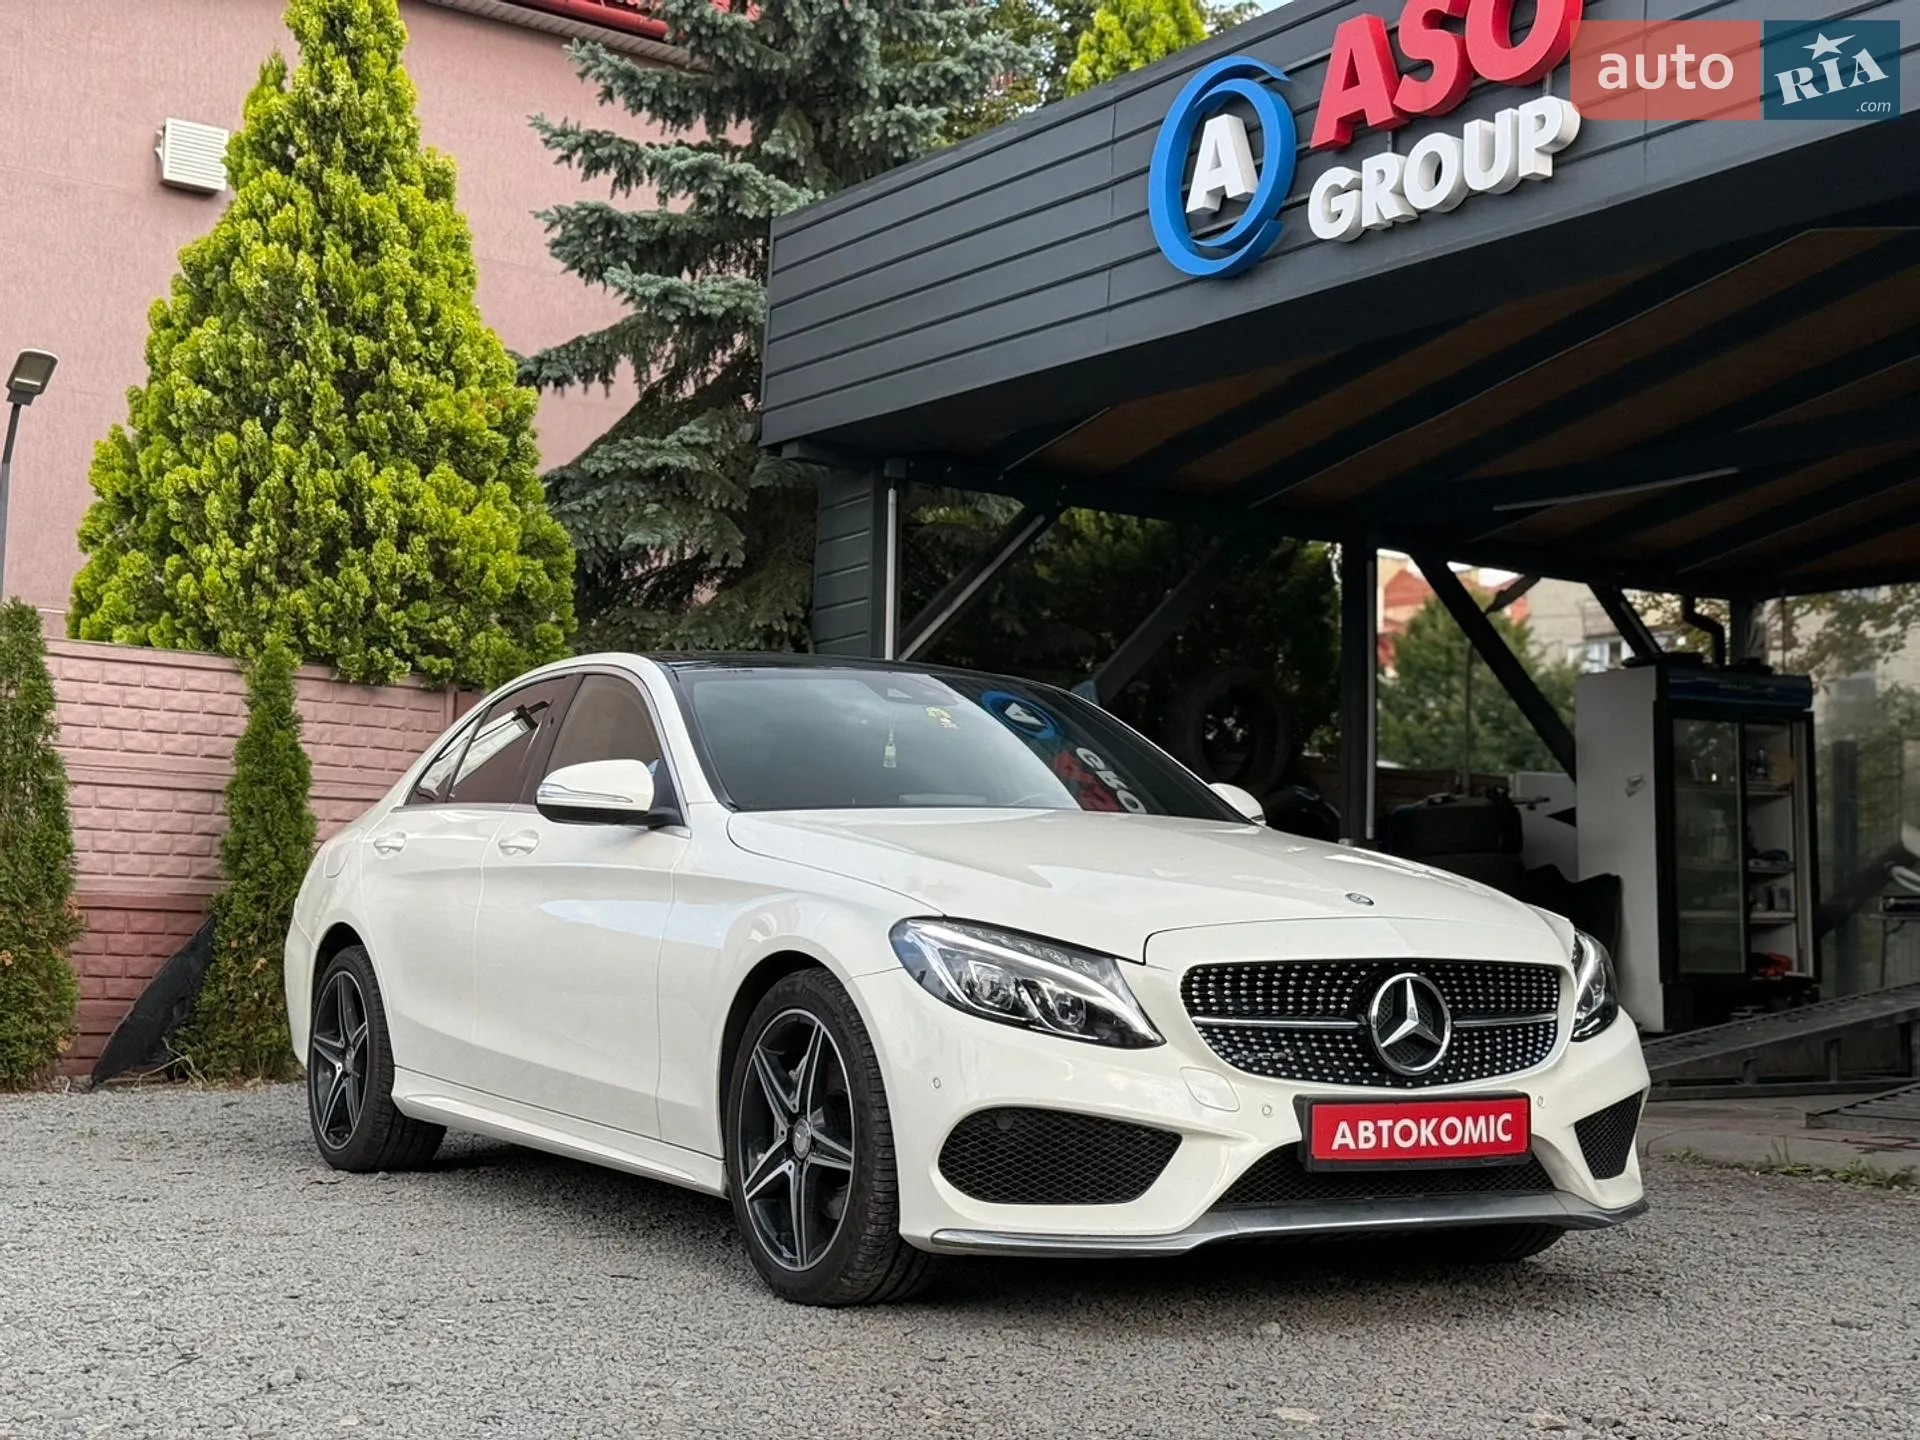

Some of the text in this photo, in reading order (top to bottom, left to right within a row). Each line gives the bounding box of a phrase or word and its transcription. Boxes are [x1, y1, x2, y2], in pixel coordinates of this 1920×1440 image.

[1310, 0, 1584, 151] ASO
[1308, 95, 1582, 243] GROUP
[1331, 1112, 1513, 1151] АВТОКОМІС
